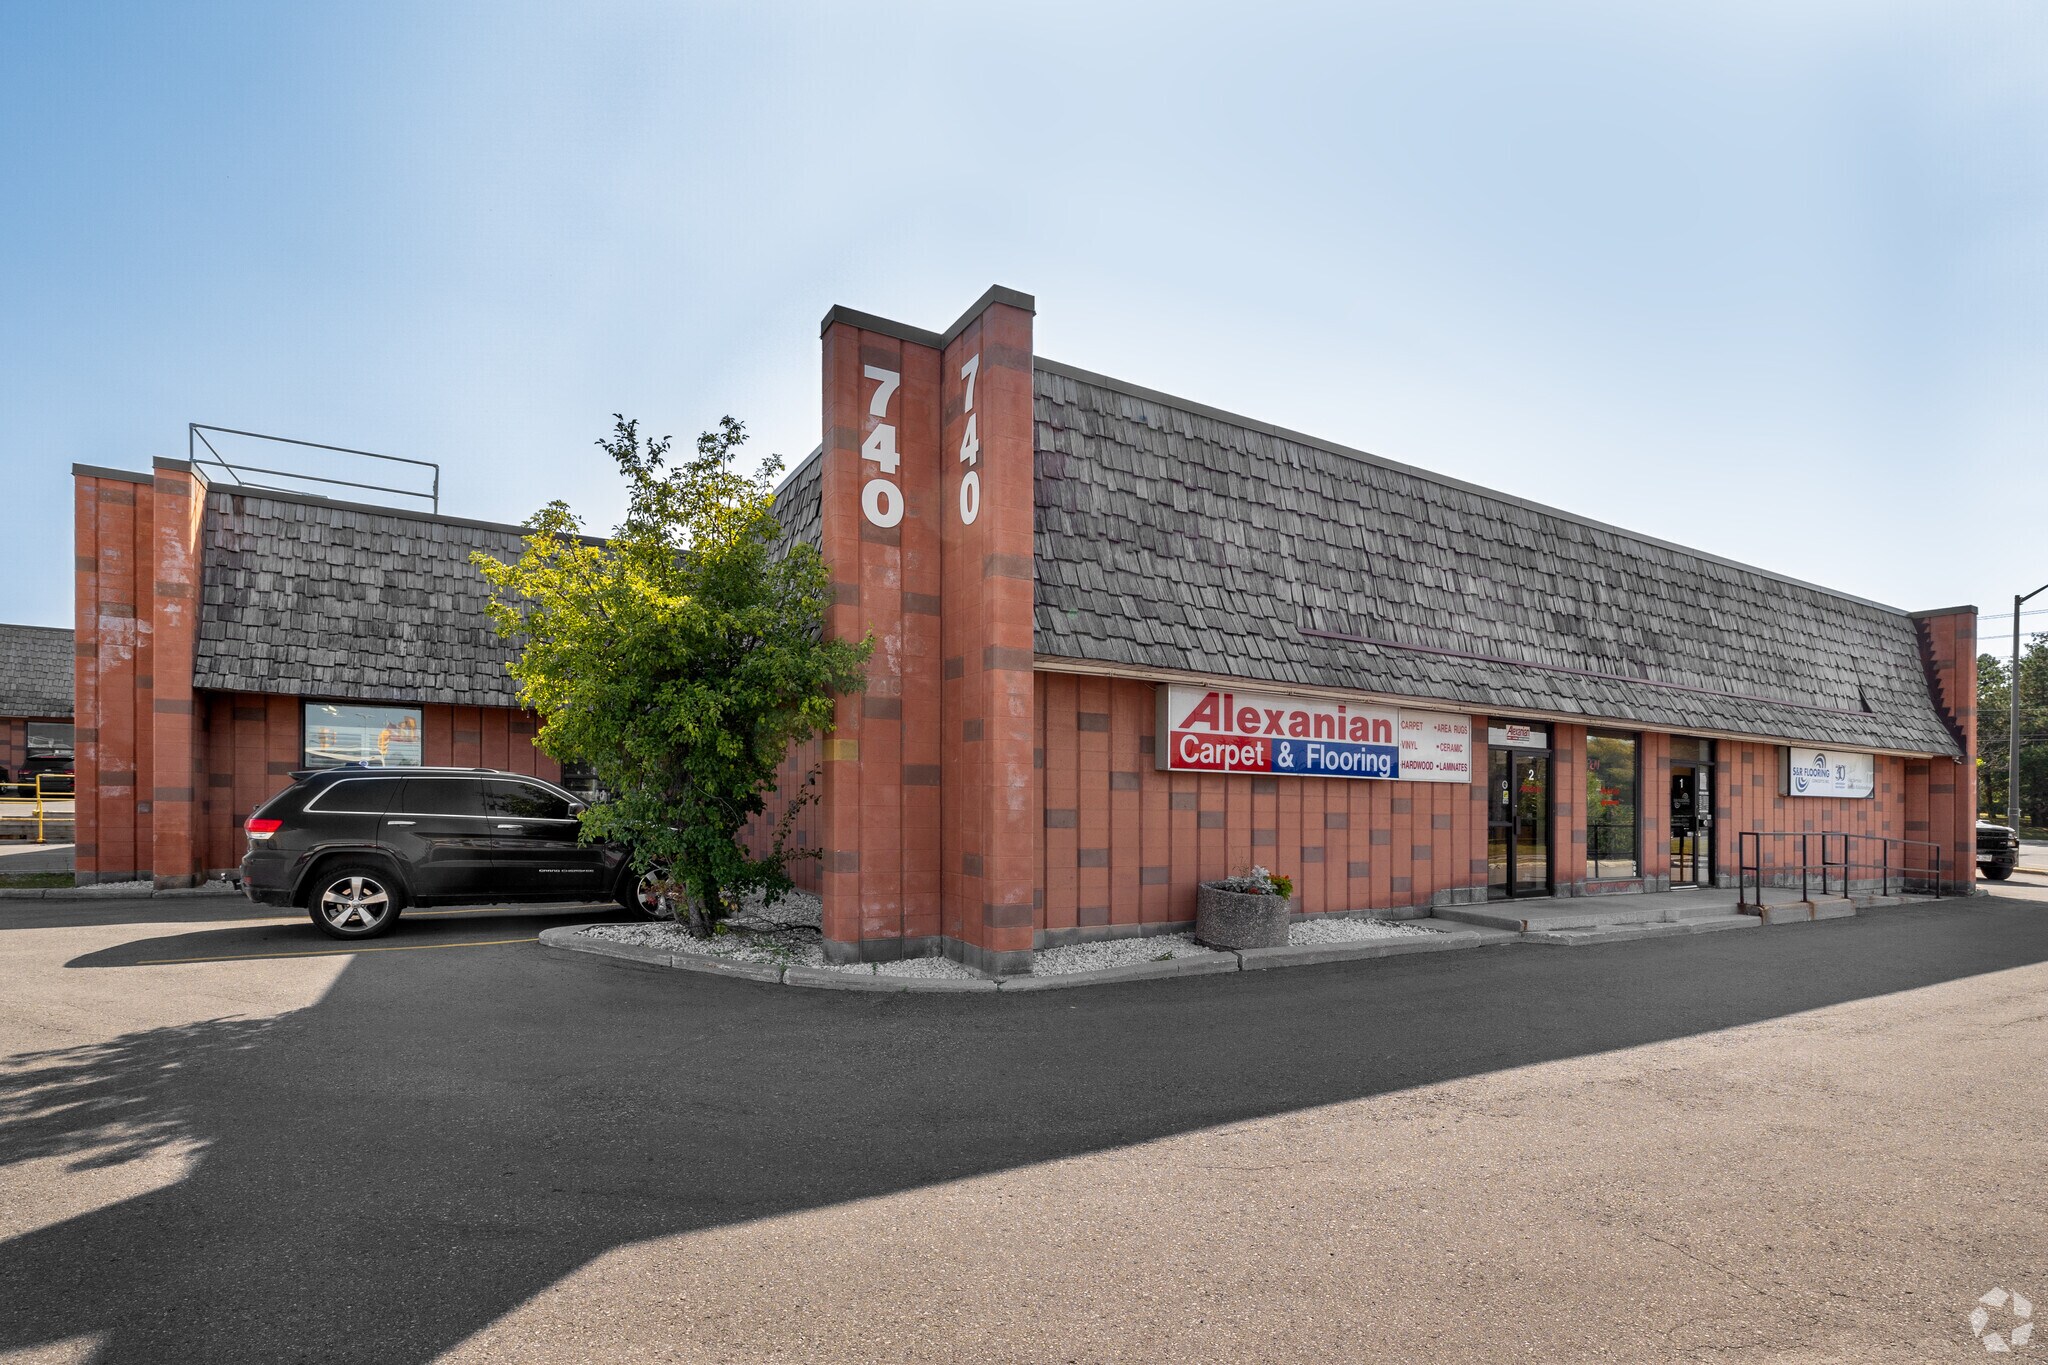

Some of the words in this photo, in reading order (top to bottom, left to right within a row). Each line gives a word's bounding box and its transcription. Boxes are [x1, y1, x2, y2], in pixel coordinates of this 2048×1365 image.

[960, 353, 980, 525] 740
[861, 364, 905, 528] 740
[1178, 692, 1392, 743] Alexanian
[1401, 720, 1423, 730] CARPET
[1437, 724, 1452, 733] AREA
[1453, 725, 1468, 735] RUGS
[1401, 740, 1418, 750] VINYL
[1440, 742, 1463, 753] CERAMIC
[1180, 734, 1264, 770] Carpet
[1278, 741, 1294, 767] &
[1307, 743, 1391, 778] Flooring
[1401, 760, 1434, 770] HARDWOOD
[1440, 762, 1468, 772] LAMINATES
[1528, 769, 1535, 781] 2
[1792, 767, 1803, 777] S&R
[1804, 767, 1830, 778] FLOORING
[1679, 778, 1684, 789] 1
